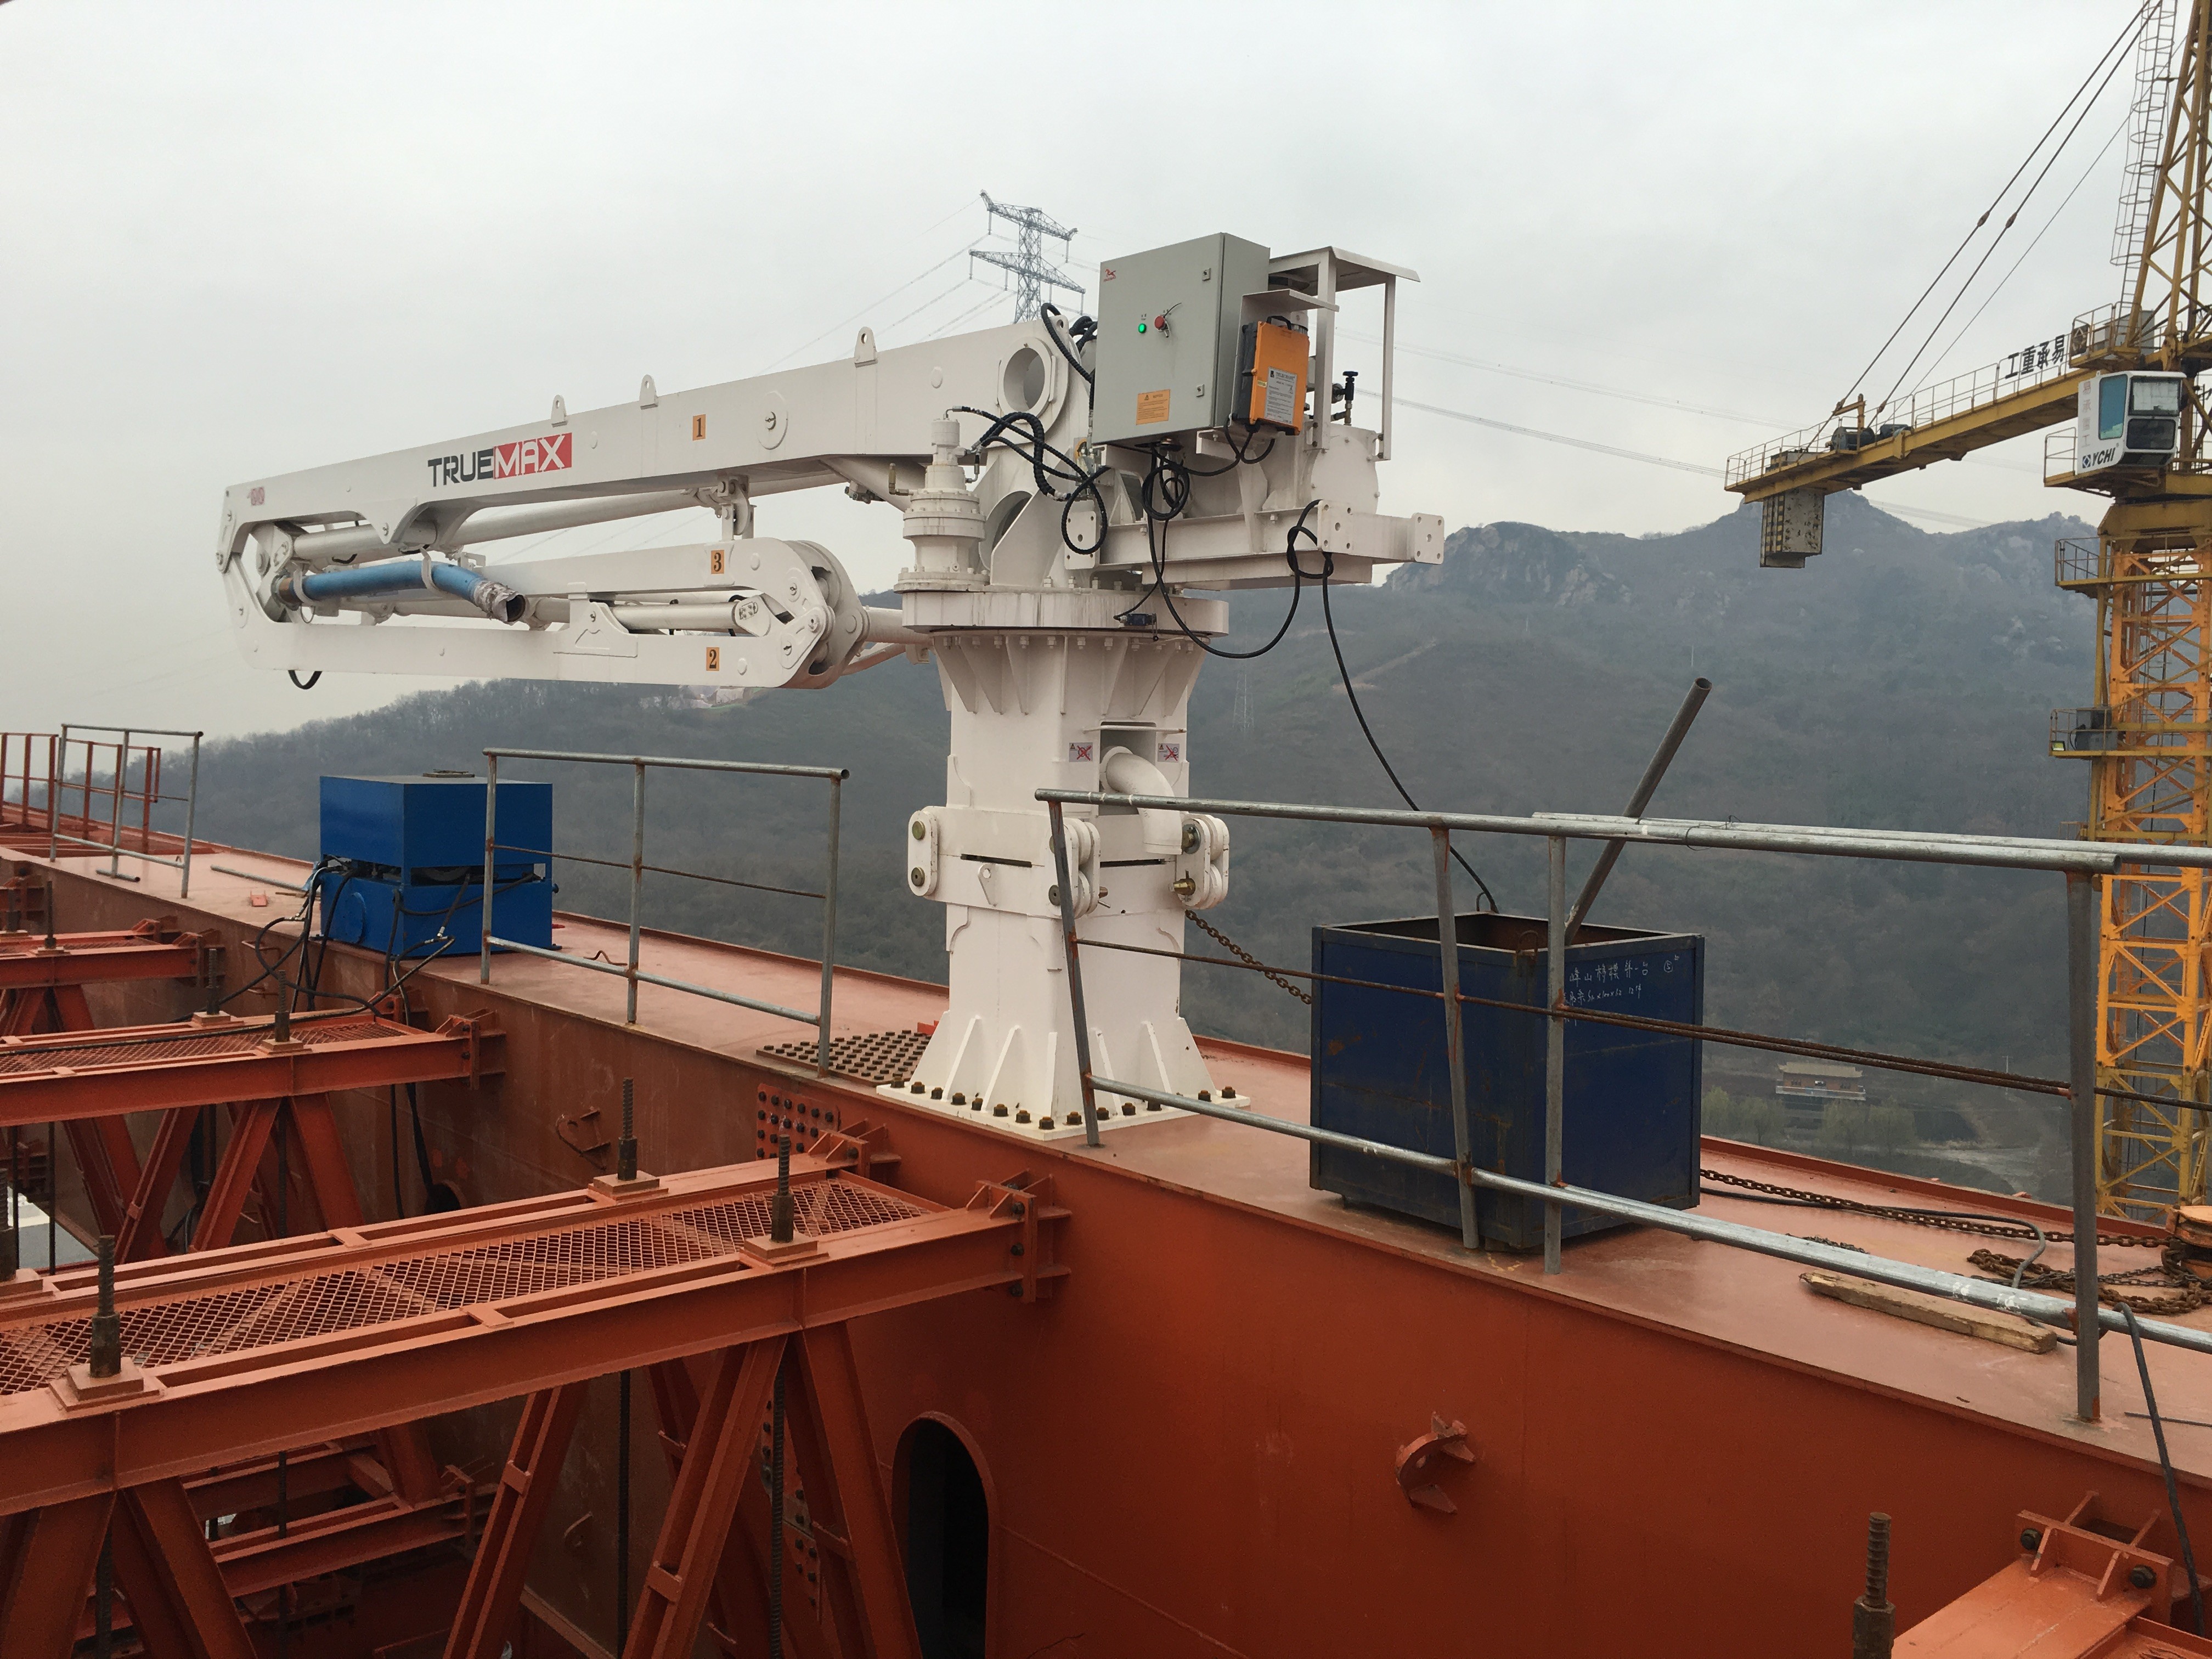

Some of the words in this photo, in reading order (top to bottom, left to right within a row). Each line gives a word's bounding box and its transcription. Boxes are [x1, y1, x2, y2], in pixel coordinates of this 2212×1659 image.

[696, 417, 703, 438] 1
[427, 433, 569, 487] TRUEMAX
[2092, 447, 2116, 466] YCHI
[714, 552, 722, 572] 3
[709, 649, 717, 669] 2
